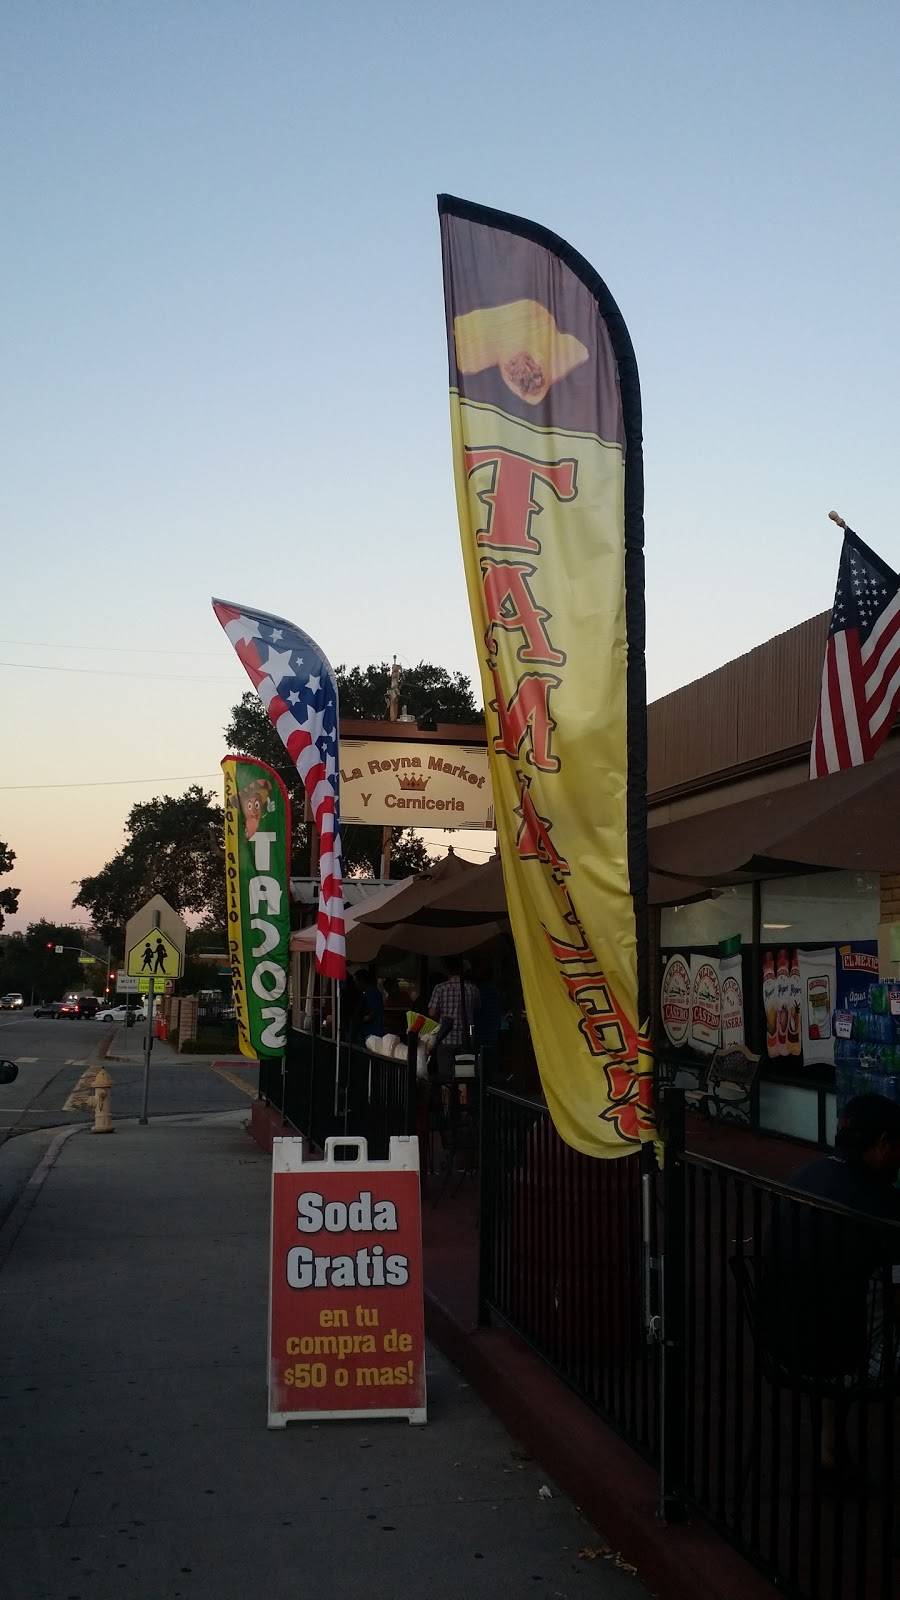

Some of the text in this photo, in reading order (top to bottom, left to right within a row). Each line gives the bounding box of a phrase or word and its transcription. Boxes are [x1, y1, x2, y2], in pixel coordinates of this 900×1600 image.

[340, 755, 486, 789] La Reyna Market
[361, 792, 465, 812] Y Carniceria
[693, 1006, 720, 1027] CASERO
[297, 1191, 398, 1233] Soda
[286, 1245, 409, 1289] Gratis
[319, 1304, 380, 1328] en tu
[286, 1328, 413, 1360] compra de
[284, 1360, 415, 1388] $50 o mas!
